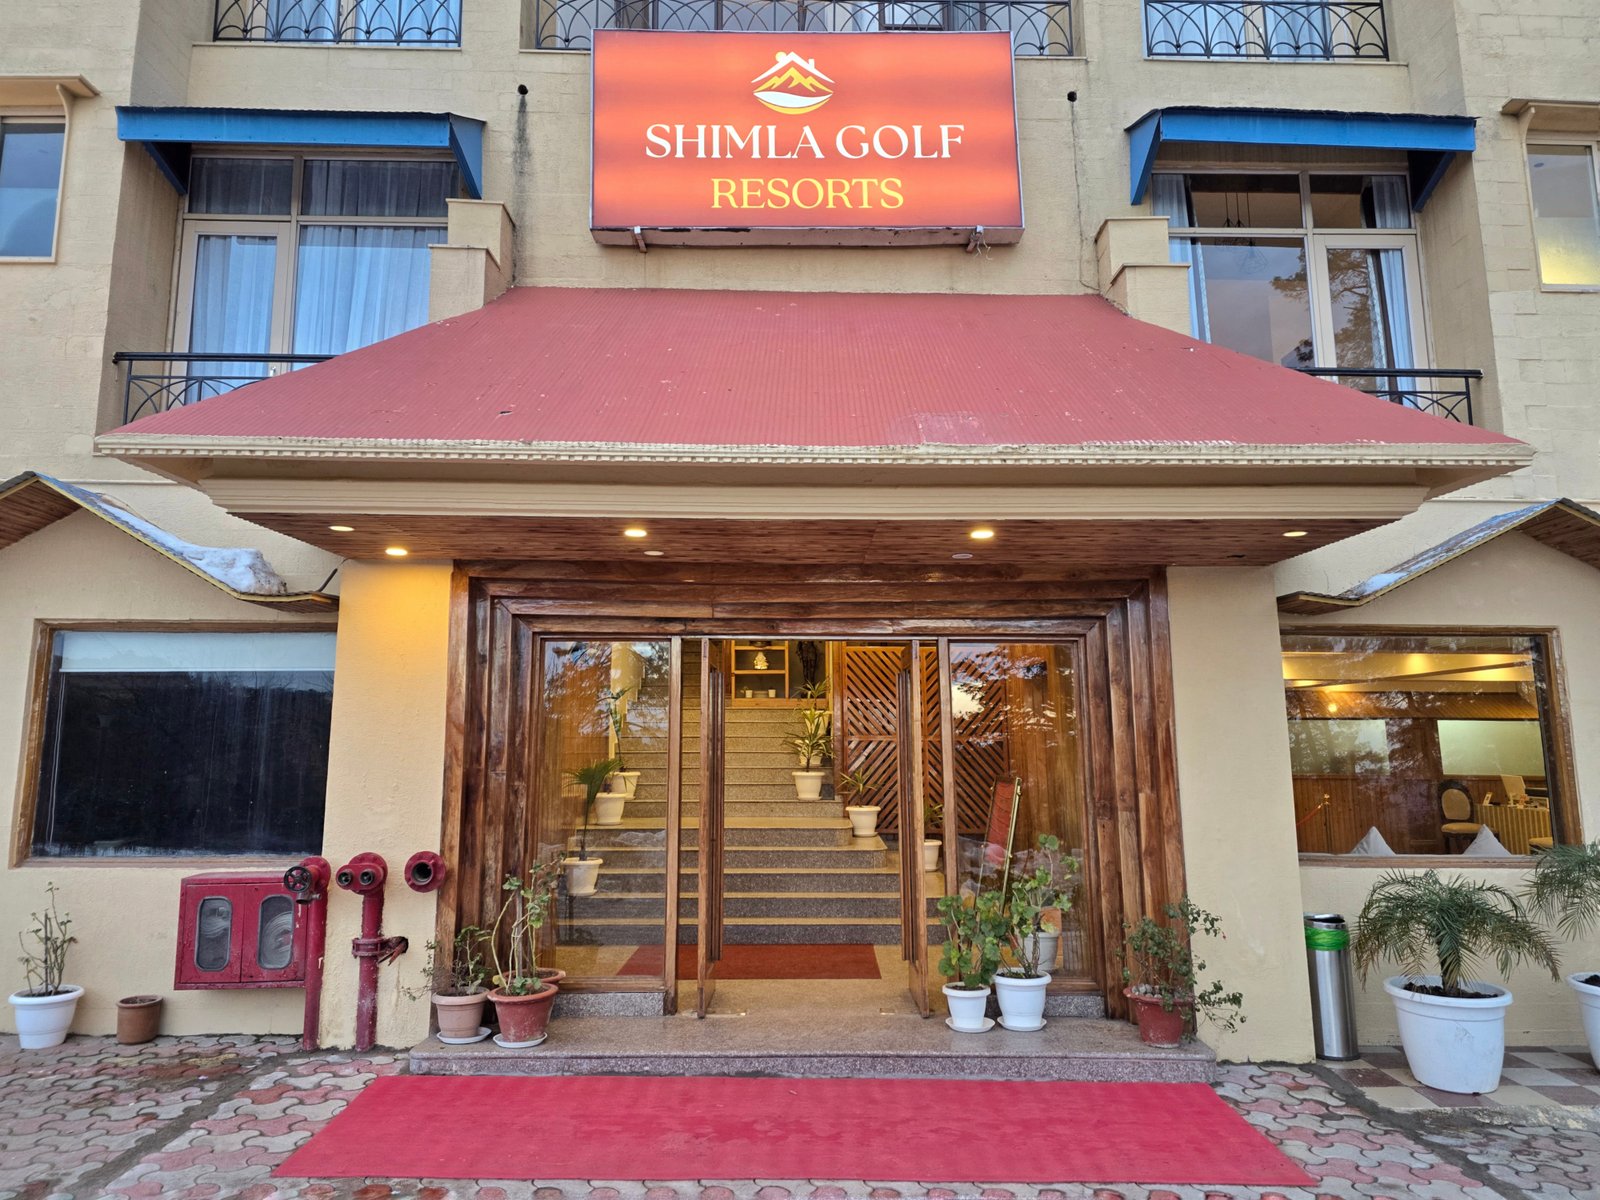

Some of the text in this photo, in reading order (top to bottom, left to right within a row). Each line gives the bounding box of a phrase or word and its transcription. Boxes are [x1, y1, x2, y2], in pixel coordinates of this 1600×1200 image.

[645, 123, 965, 159] SHIMLA GOLF
[711, 177, 904, 209] RESORTS
